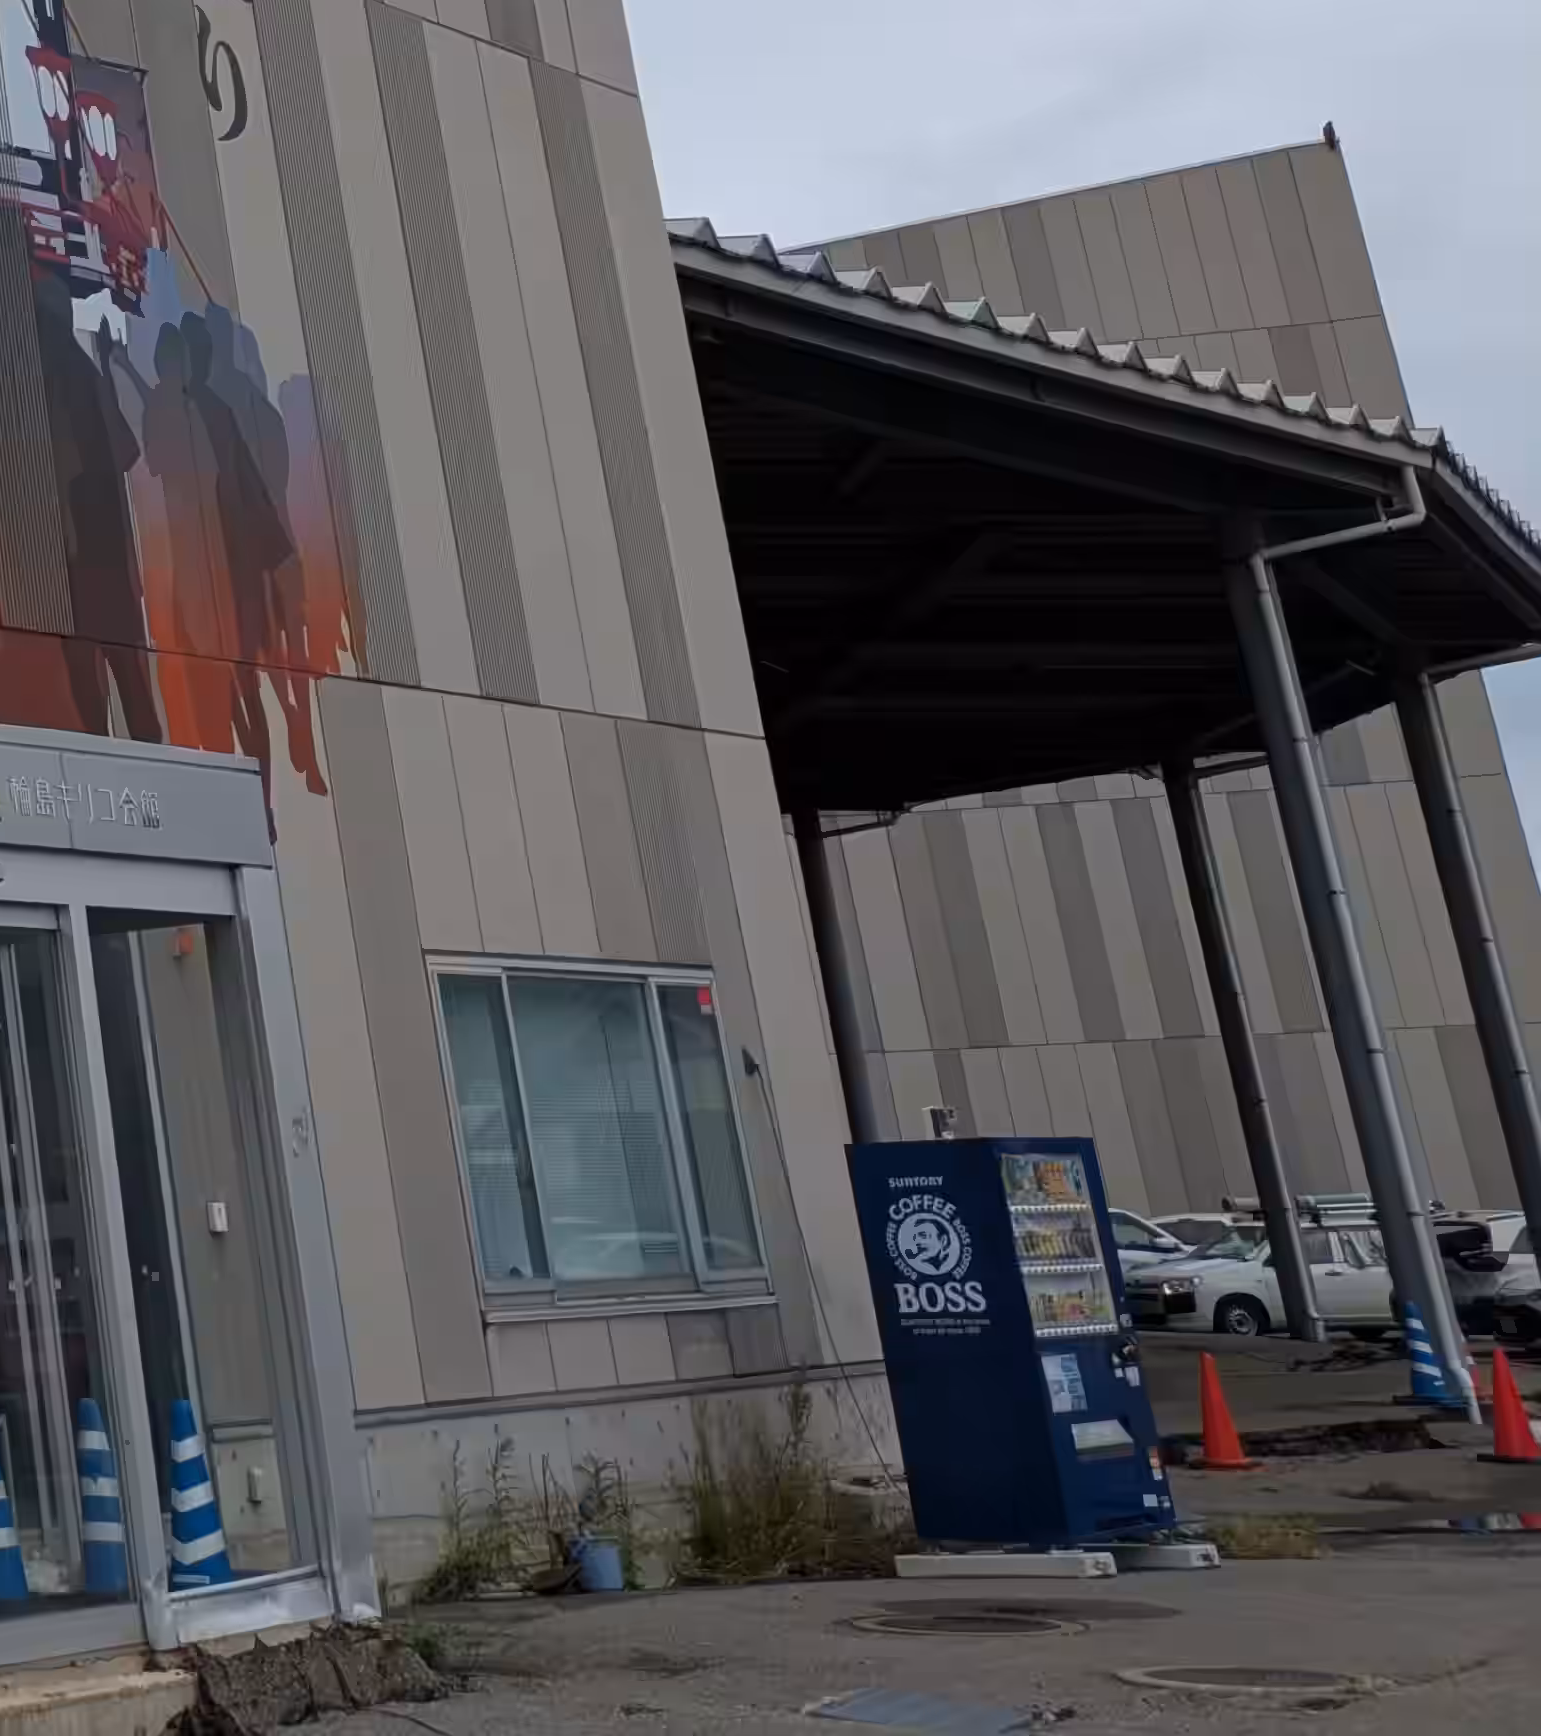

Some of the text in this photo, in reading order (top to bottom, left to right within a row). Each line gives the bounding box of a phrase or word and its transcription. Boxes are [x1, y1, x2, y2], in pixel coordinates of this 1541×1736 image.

[5, 775, 163, 829] 輪島キリコ会館
[889, 1194, 957, 1221] COFFEE
[893, 1280, 987, 1313] BOSS
